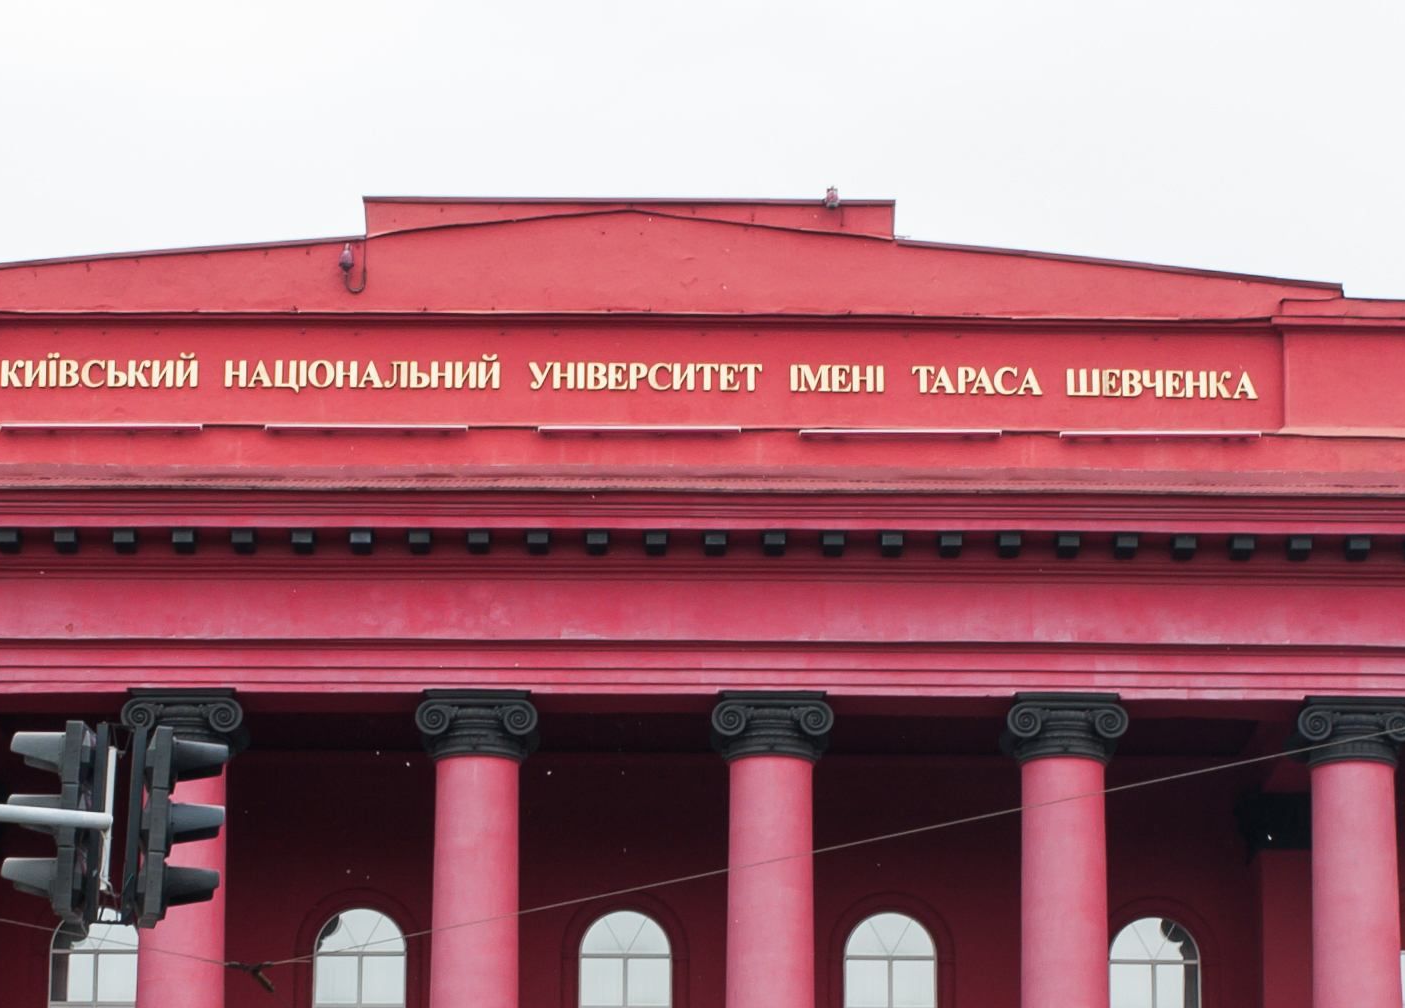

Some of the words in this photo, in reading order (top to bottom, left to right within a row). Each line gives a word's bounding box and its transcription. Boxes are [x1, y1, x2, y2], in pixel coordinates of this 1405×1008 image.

[0, 351, 199, 388] КИЇВСЬКИЙ
[224, 353, 501, 393] НАЦІОНАЛЬНИЙ
[528, 361, 763, 392] УНІВЕРСИТЕТ
[789, 364, 885, 393] ІМЕНІ
[911, 365, 1043, 396] ТАРАСА
[1066, 367, 1259, 400] ШЕВЧЕНКА
